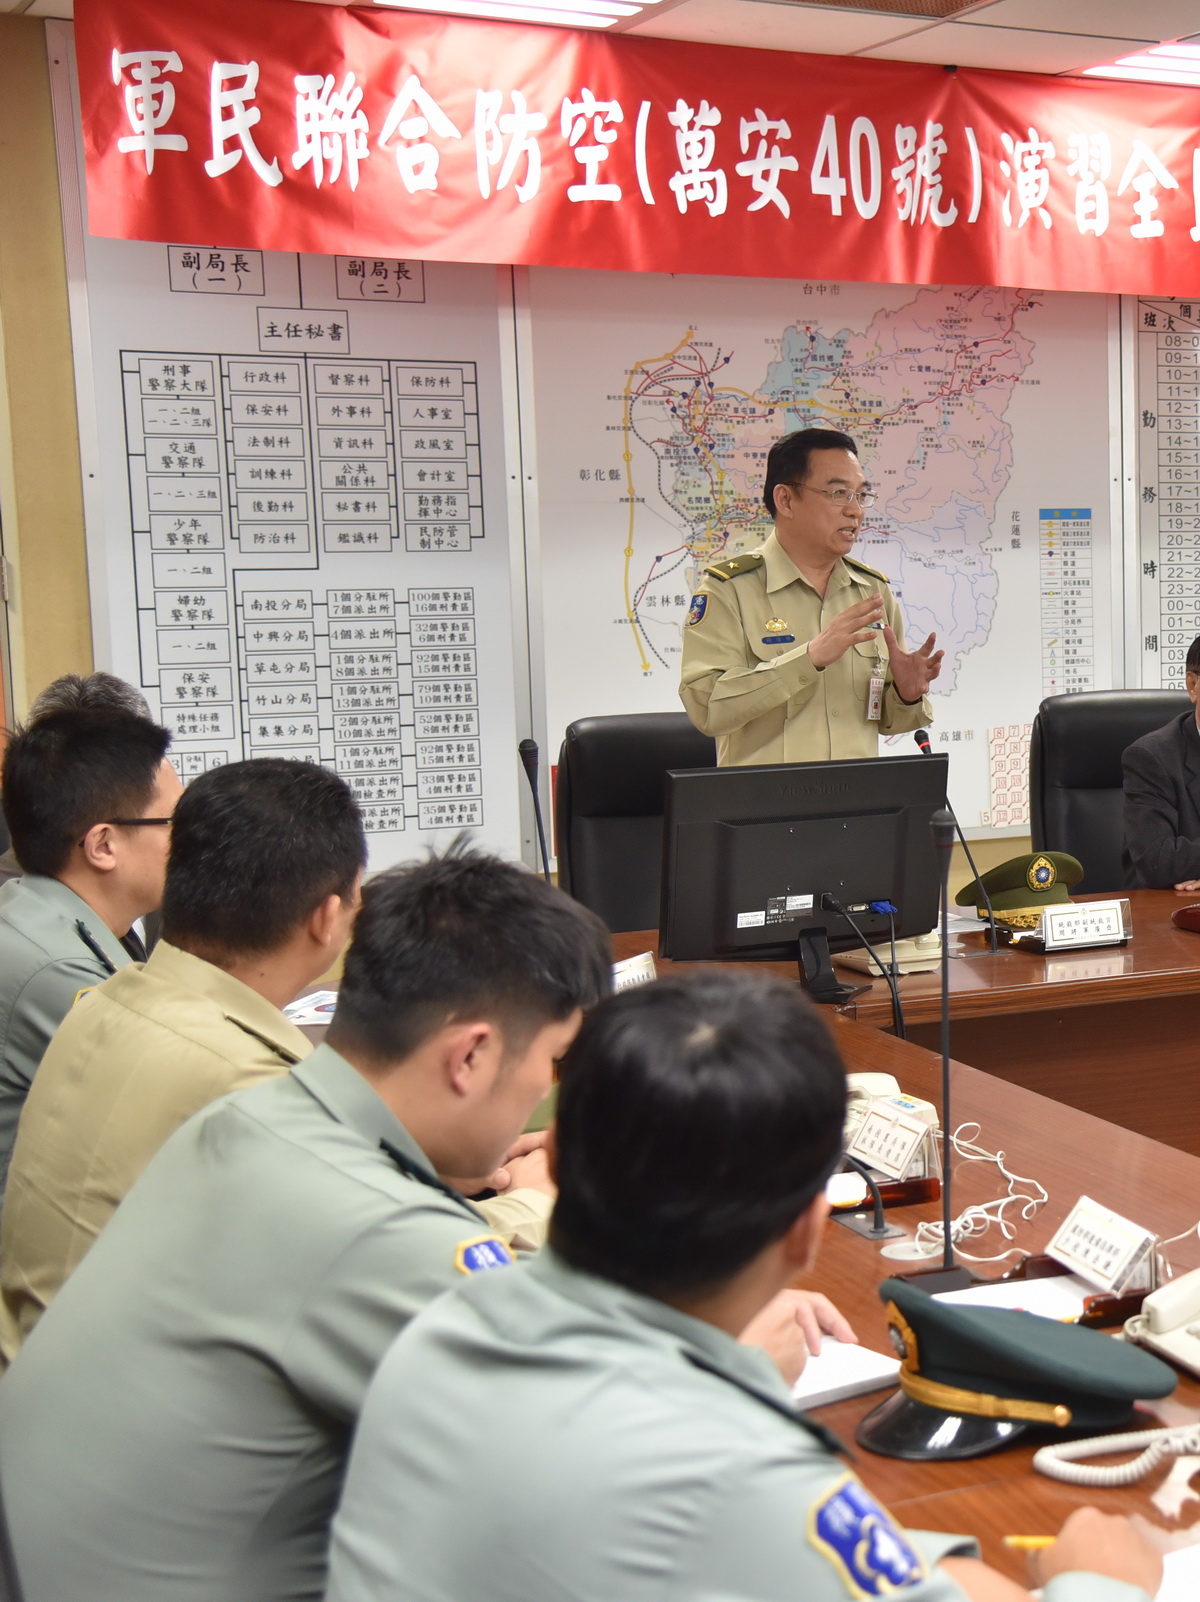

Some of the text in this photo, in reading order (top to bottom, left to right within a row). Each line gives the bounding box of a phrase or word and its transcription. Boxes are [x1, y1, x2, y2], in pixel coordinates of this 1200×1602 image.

[182, 252, 251, 273] 副局長
[348, 261, 412, 280] 副局長
[803, 284, 840, 296] 台中市
[1144, 312, 1176, 331] 班次
[264, 321, 344, 341] 主任秘書
[811, 353, 834, 362] 國姓鄉
[162, 364, 192, 376] 刑事
[909, 365, 931, 373] 仁愛鄉
[243, 371, 287, 383] 行政科
[329, 374, 370, 386] 督察科
[411, 376, 451, 388] 保防科
[148, 379, 208, 392] 警察大隊
[246, 404, 289, 416] 保安科
[860, 400, 882, 408] 埔里鎮
[331, 406, 372, 418] 外事科
[413, 408, 452, 420] 人事室
[733, 406, 756, 415] 草屯鎮
[169, 442, 197, 454] 交通
[248, 436, 291, 448] 法制科
[333, 438, 374, 449] 資訊科
[414, 439, 454, 451] 政風室
[664, 448, 688, 456] 南投市
[161, 456, 206, 469] 警察隊
[249, 468, 292, 480] 訓練科
[342, 464, 368, 474] 公共
[579, 469, 621, 481] 彰化縣
[335, 476, 376, 487] 關係科
[417, 469, 456, 482] 會計室
[418, 495, 457, 506] 勤務指
[687, 496, 710, 504] 名間鄉
[252, 501, 294, 512] 後勤科
[336, 501, 378, 512] 秘書科
[418, 507, 457, 518] 揮中心
[174, 519, 202, 531] 少年
[1011, 510, 1021, 550] 花蓮縣
[253, 532, 296, 544] 防治科
[338, 532, 379, 543] 鑑識科
[419, 526, 458, 538] 民防管
[166, 532, 211, 545] 警察隊
[419, 538, 459, 549] 制中心
[178, 595, 206, 606] 婦幼
[251, 599, 307, 611] 南投分局
[646, 595, 686, 607] 雲林縣
[171, 608, 214, 621] 警察隊
[332, 604, 390, 615] 7個派出所
[253, 630, 309, 643] 中興分局
[331, 628, 394, 641] 4個派出所
[254, 662, 310, 674] 草屯分局
[336, 665, 394, 677] 8個派出所
[182, 672, 210, 684] 保安
[175, 686, 219, 698] 警察隊
[256, 693, 312, 706] 竹山分局
[176, 712, 219, 723] 特殊任務
[177, 725, 221, 734] 處理小組
[258, 724, 314, 738] 集集分局
[939, 730, 974, 742] 高雄市
